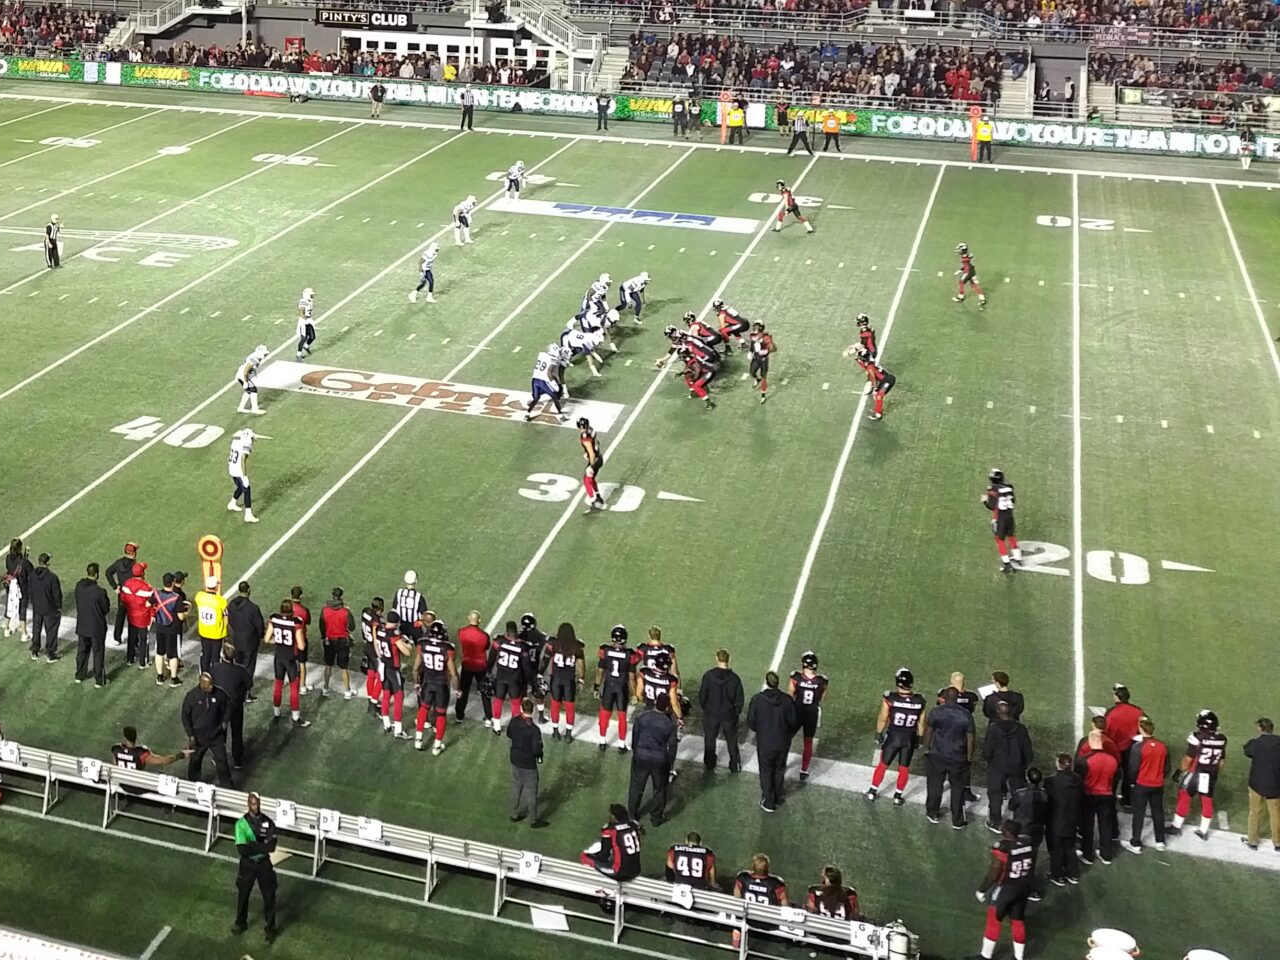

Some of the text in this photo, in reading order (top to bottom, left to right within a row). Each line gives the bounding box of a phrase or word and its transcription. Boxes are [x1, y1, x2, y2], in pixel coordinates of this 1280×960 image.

[322, 11, 408, 27] PINTY'S CLUB
[366, 392, 562, 425] PIZZA
[110, 415, 225, 448] 40
[519, 472, 645, 512] 30
[1010, 541, 1150, 585] 20
[274, 627, 293, 646] 83
[423, 653, 444, 671] 96
[611, 660, 620, 677] 1
[1199, 748, 1223, 764] 27
[677, 855, 704, 878] 49
